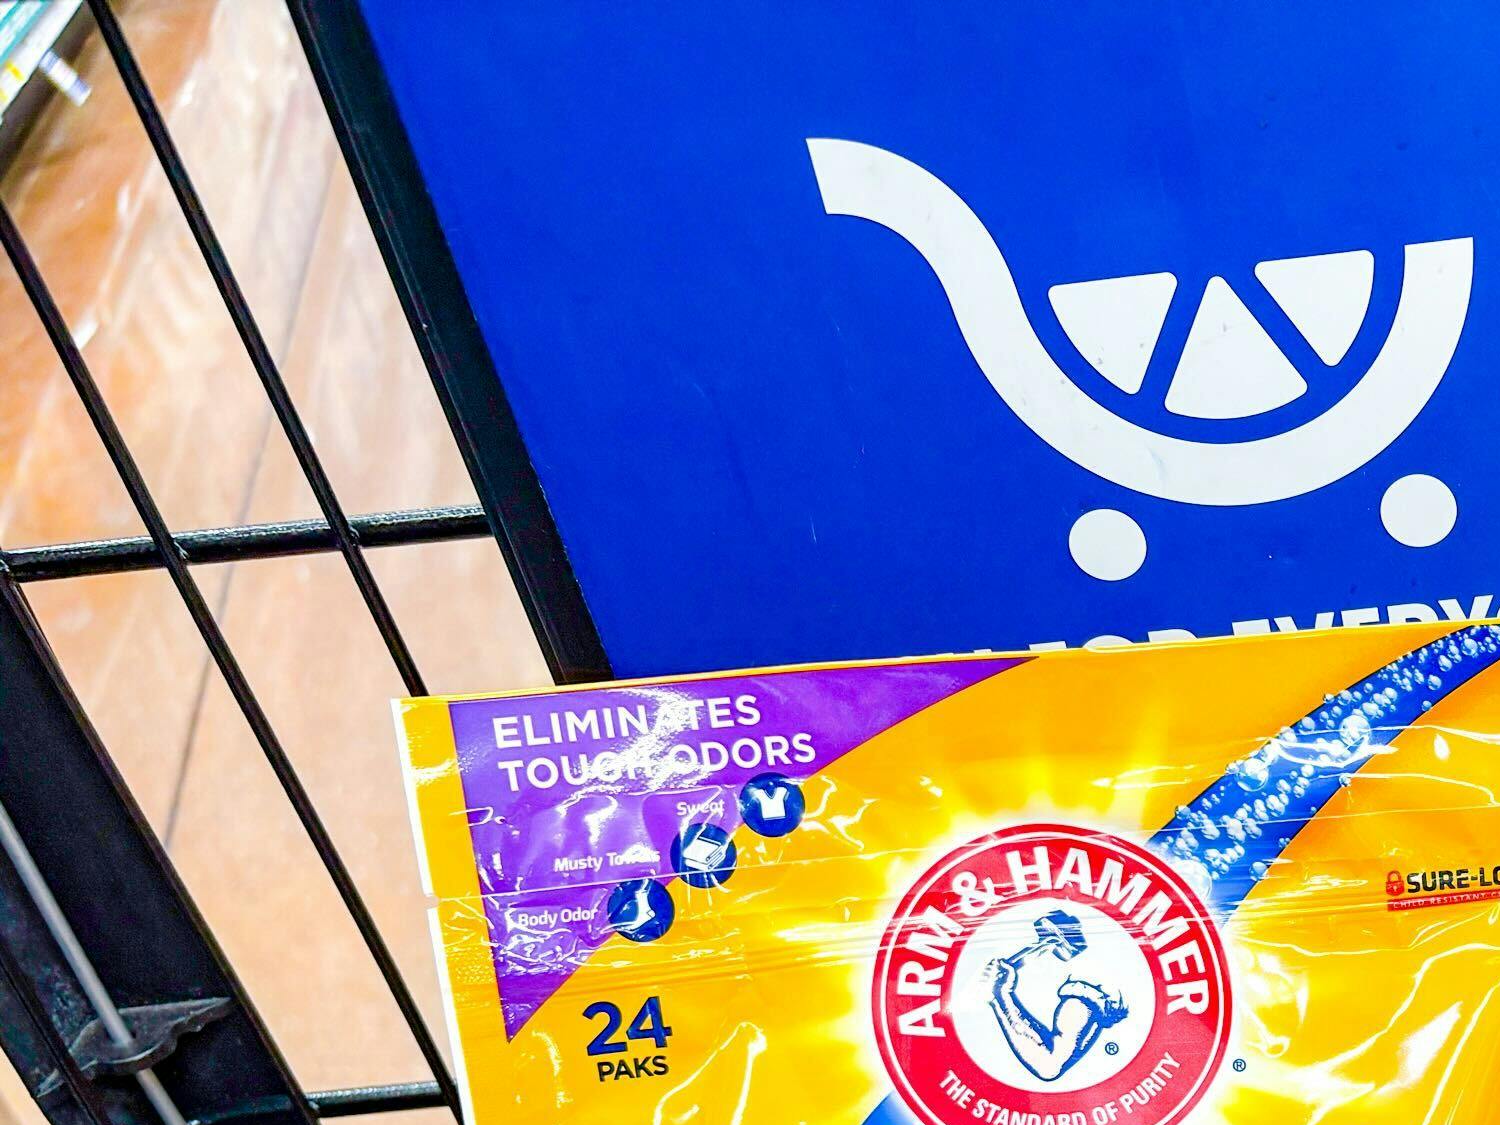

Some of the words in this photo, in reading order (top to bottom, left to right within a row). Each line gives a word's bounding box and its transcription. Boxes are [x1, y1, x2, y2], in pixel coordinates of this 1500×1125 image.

[664, 732, 817, 779] ODORS
[554, 854, 604, 873] Musty
[606, 851, 661, 867] Tows
[517, 911, 558, 929] Body
[560, 906, 599, 923] Odor
[1429, 892, 1487, 906] RESISTANT
[896, 906, 967, 1038] ARM
[951, 869, 1004, 918] &
[1006, 844, 1210, 1017] HAMMER
[581, 996, 673, 1057] 24
[596, 1054, 670, 1083] PAKS
[938, 1068, 972, 1110] THE
[1121, 1051, 1182, 1118] PURITY
